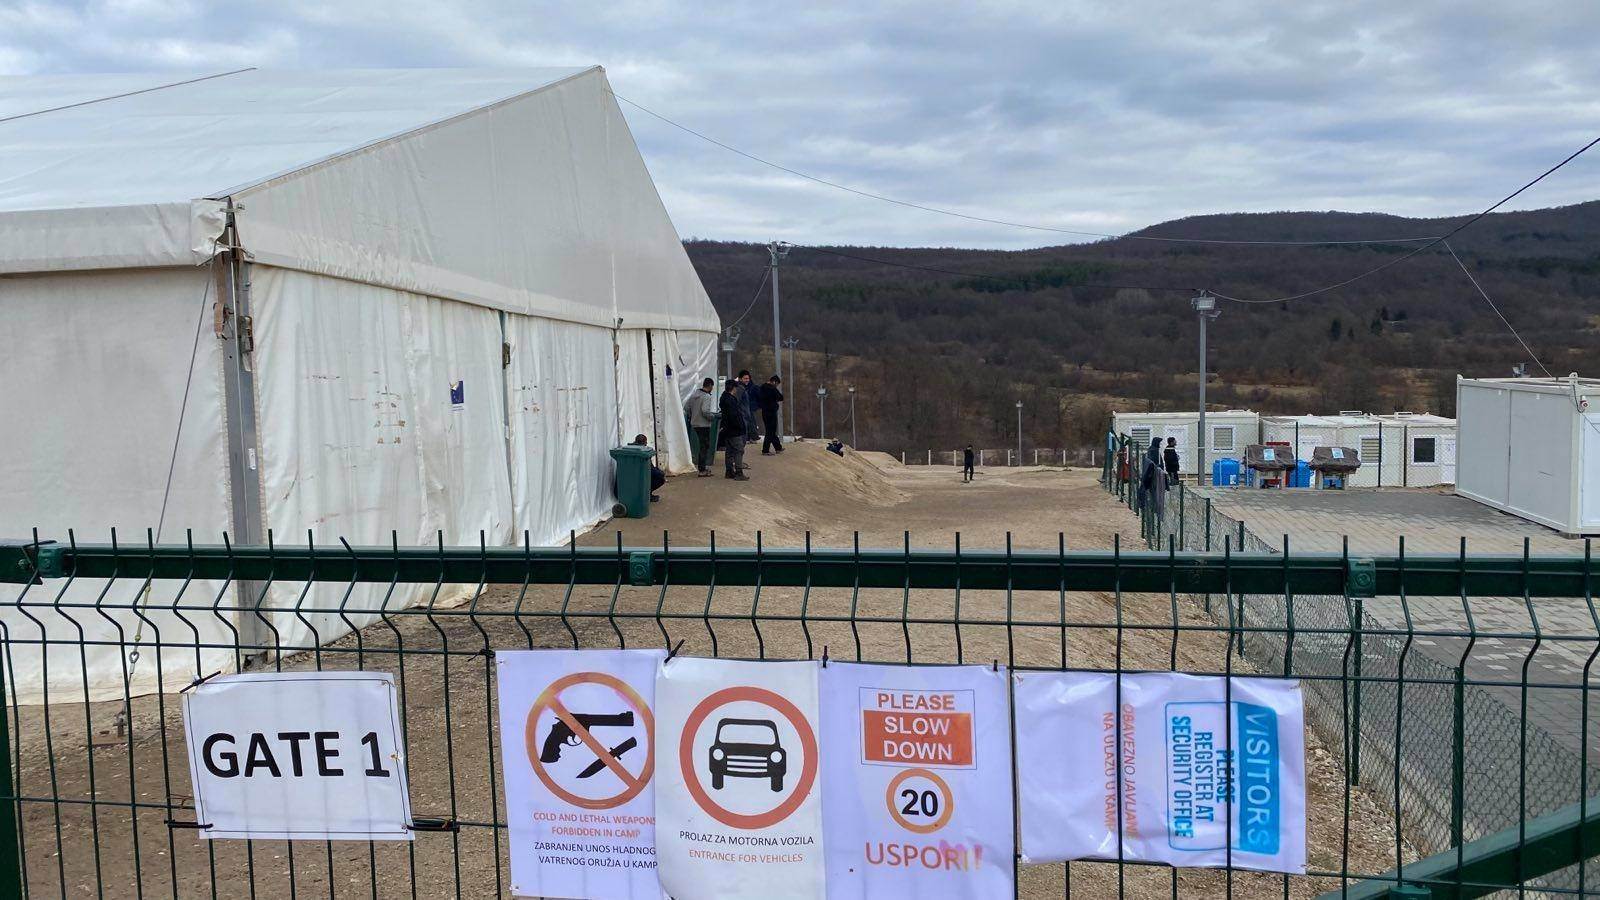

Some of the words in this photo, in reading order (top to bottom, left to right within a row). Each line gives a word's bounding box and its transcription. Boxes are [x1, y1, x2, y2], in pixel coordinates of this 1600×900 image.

[877, 693, 955, 710] PLEASE
[884, 716, 950, 736] SLOW
[1103, 711, 1115, 731] NA
[1122, 703, 1136, 776] OBAVEZNO
[202, 732, 344, 778] GATE
[361, 732, 390, 777] 1
[883, 740, 952, 760] DOWN
[1103, 734, 1116, 777] ULAZU
[1172, 716, 1192, 786] SECURITY
[1194, 731, 1214, 801] REGISTER
[1105, 780, 1116, 790] U
[1216, 749, 1236, 804] PLEASE
[1245, 713, 1271, 845] VISITORS
[901, 789, 939, 817] 20
[533, 812, 556, 821] COLD
[558, 813, 577, 822] AND
[579, 814, 610, 823] LETHAL
[1174, 790, 1194, 838] OFFICE
[1195, 805, 1214, 822] AT
[551, 826, 600, 836] FORBIDDEN
[603, 829, 612, 837] IN
[614, 829, 641, 838] CAMP
[679, 830, 712, 843] PROLAZ
[714, 834, 726, 844] ZA
[728, 836, 778, 846] MOTORNA
[780, 836, 814, 846] VOZILA
[534, 842, 583, 852] ZABRANJEN
[585, 845, 610, 853] UNOS
[612, 846, 656, 855] HLADNOG
[689, 849, 735, 862] ENTRANCE
[738, 853, 757, 863] FOR
[759, 853, 803, 863] VEHICLES
[538, 855, 585, 866] VATRENOG
[587, 857, 621, 868] ORUŽJA
[623, 860, 630, 868] U
[632, 860, 658, 869] KAMP
